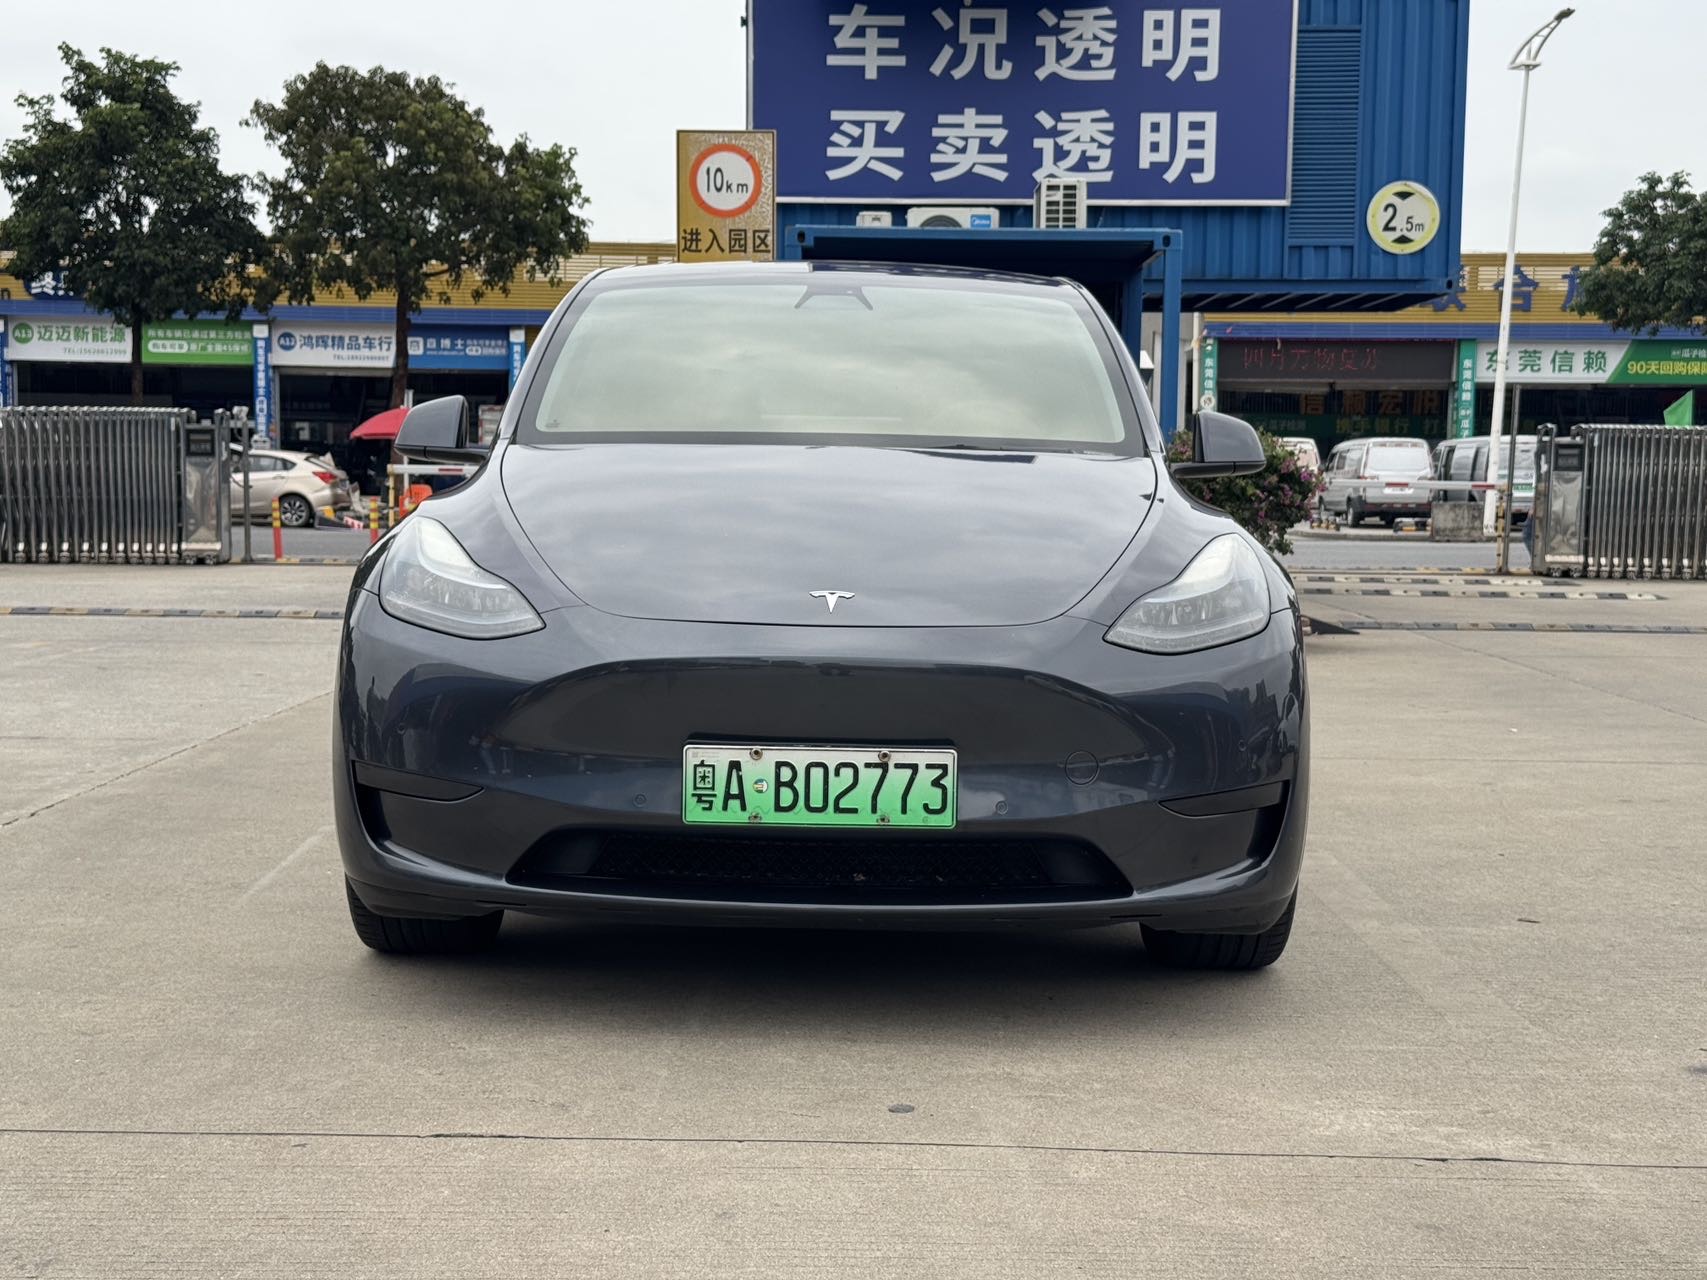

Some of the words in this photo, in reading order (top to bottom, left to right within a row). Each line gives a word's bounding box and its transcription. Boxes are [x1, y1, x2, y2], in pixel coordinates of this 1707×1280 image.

[826, 4, 1221, 82] 车况透明
[825, 107, 1218, 183] 买卖透明
[1382, 203, 1424, 232] 2.5m
[682, 228, 771, 254] 进入园区
[37, 324, 126, 343] 迈迈新能源
[1485, 349, 1608, 374] 东莞信赖
